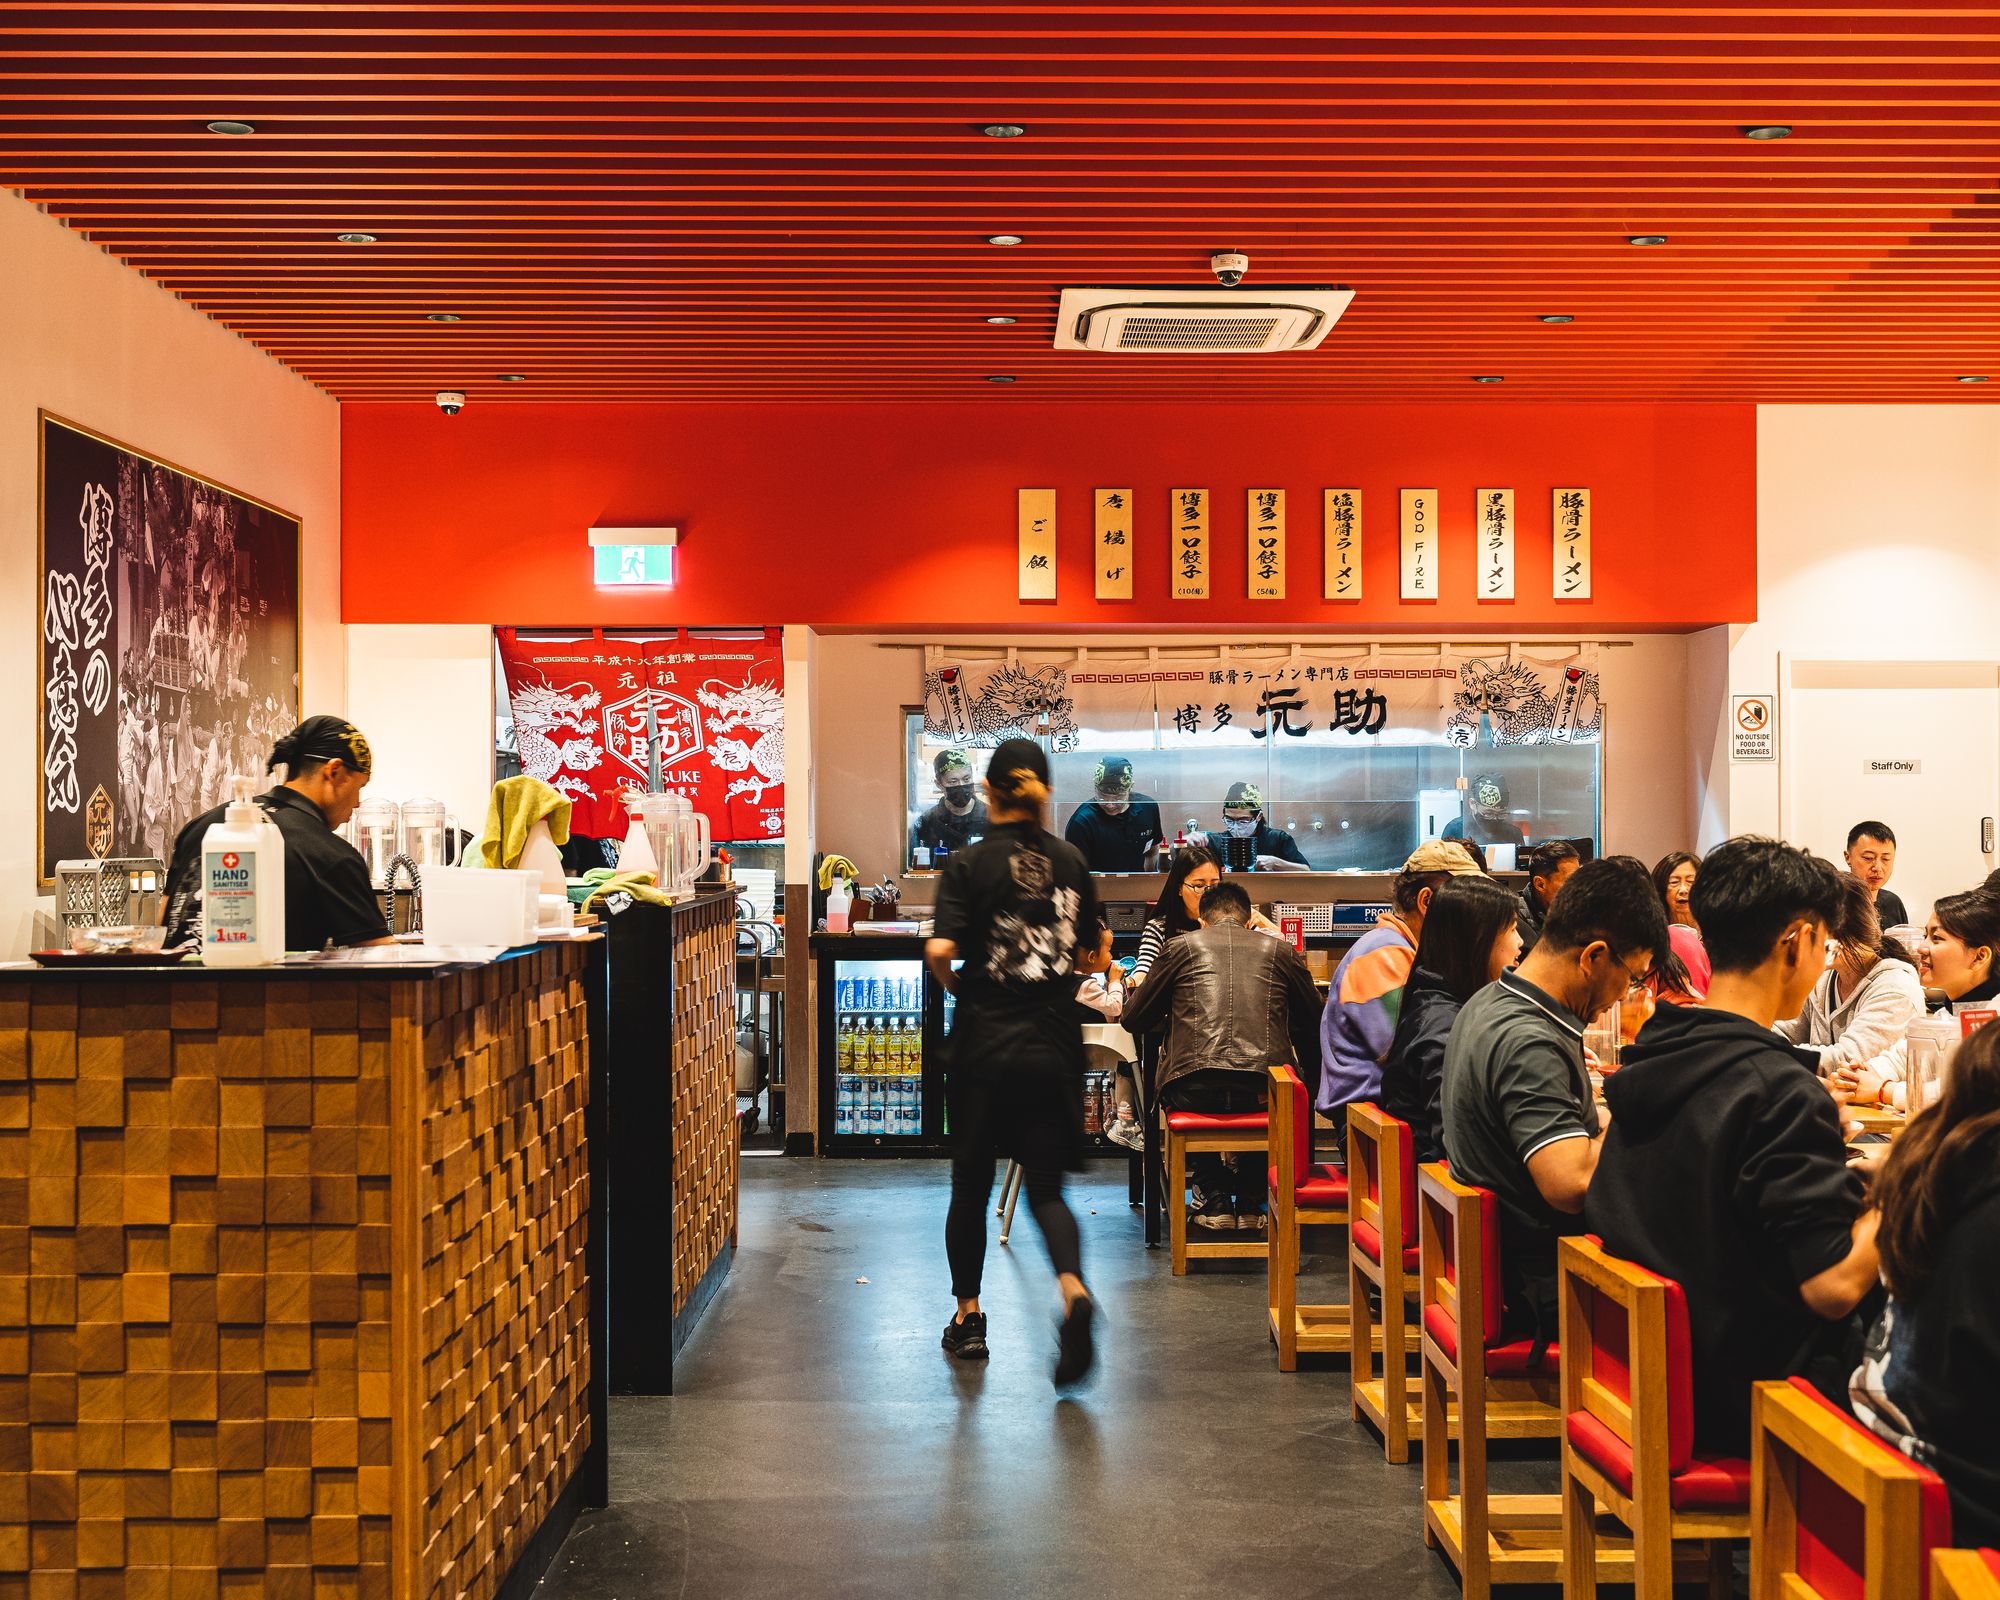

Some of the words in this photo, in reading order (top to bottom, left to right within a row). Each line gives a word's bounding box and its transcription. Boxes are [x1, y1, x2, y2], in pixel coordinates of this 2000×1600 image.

[1102, 493, 1125, 580] 唐揚げ
[1179, 492, 1203, 579] 博多一口餃子
[1256, 492, 1278, 579] 博多一口餃子
[1414, 498, 1425, 533] GOD
[1025, 518, 1049, 570] ご飯
[1332, 492, 1355, 593] 塩豚骨ラーメン
[1414, 541, 1425, 589] FIRE
[1484, 492, 1507, 593] 黒豚骨ラーメン
[1559, 492, 1585, 593] 豚骨ラーメン
[592, 653, 696, 666] 平成十八年創業
[617, 671, 678, 689] 元祖
[1208, 666, 1349, 685] 豚骨ラーメン専門店
[1173, 702, 1233, 734] 博多
[1249, 687, 1388, 739] 元助
[1871, 761, 1893, 770] Staff
[1893, 761, 1914, 772] Only
[212, 869, 249, 880] HAND
[1285, 922, 1297, 932] 101
